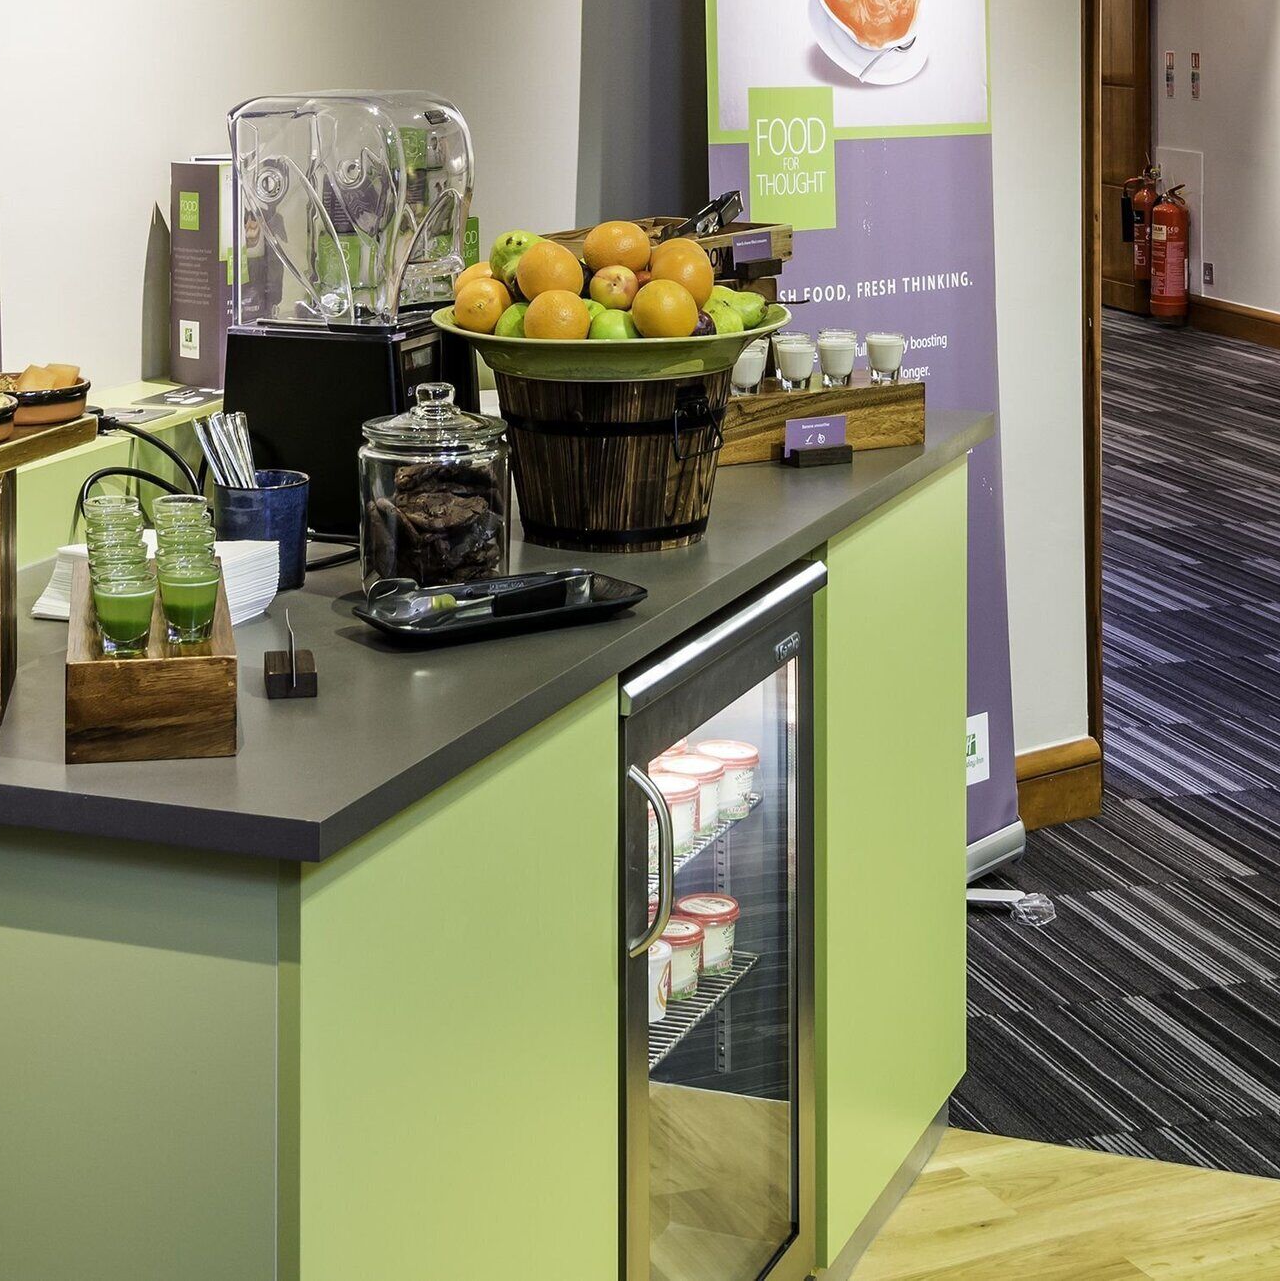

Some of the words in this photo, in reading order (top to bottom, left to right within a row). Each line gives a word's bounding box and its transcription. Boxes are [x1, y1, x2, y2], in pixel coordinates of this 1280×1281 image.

[756, 117, 826, 157] FOOD
[782, 156, 799, 171] FOR
[756, 170, 826, 196] THOUGHT
[803, 283, 851, 303] FOOD,
[857, 277, 896, 299] FRESH
[902, 271, 973, 294] THINKING.
[911, 333, 948, 351] boosting
[900, 365, 931, 381] longer.
